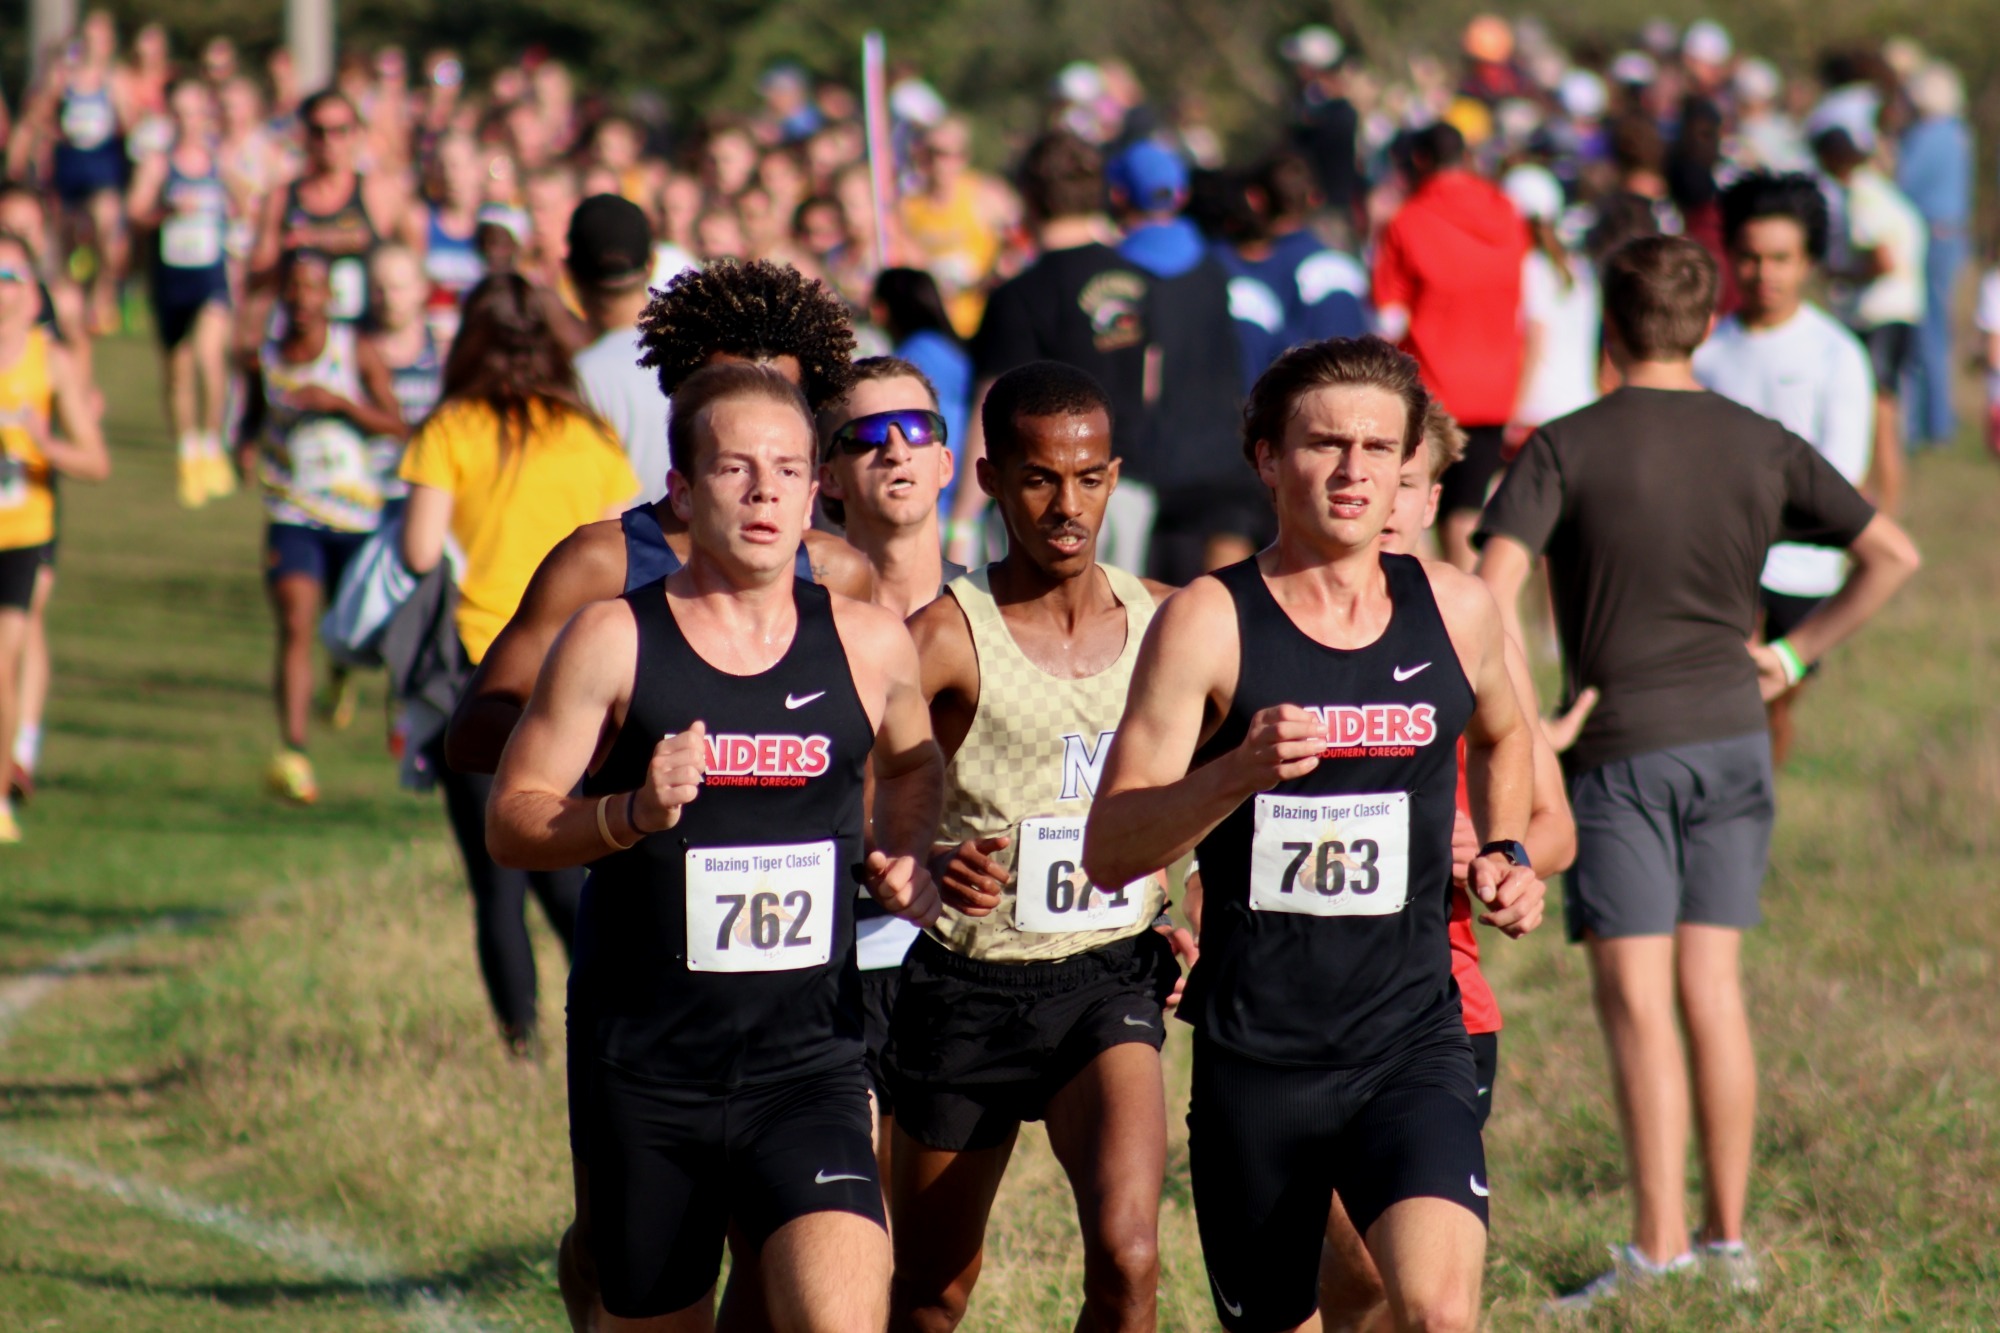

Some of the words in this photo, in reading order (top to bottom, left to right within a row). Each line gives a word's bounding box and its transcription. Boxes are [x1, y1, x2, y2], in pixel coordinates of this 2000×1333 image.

[700, 734, 831, 777] AIDERS
[1368, 746, 1415, 757] OREGON
[706, 776, 758, 787] SOUTHERN
[760, 776, 807, 787] OREGON
[1273, 804, 1317, 822] Blazing
[1321, 805, 1350, 821] Tiger
[1353, 802, 1390, 818] Classic
[1038, 826, 1080, 841] Blazing
[705, 857, 750, 873] Blazing
[753, 855, 782, 871] Tiger
[786, 852, 821, 868] Classic
[1280, 838, 1380, 896] 763
[715, 889, 813, 951] 762
